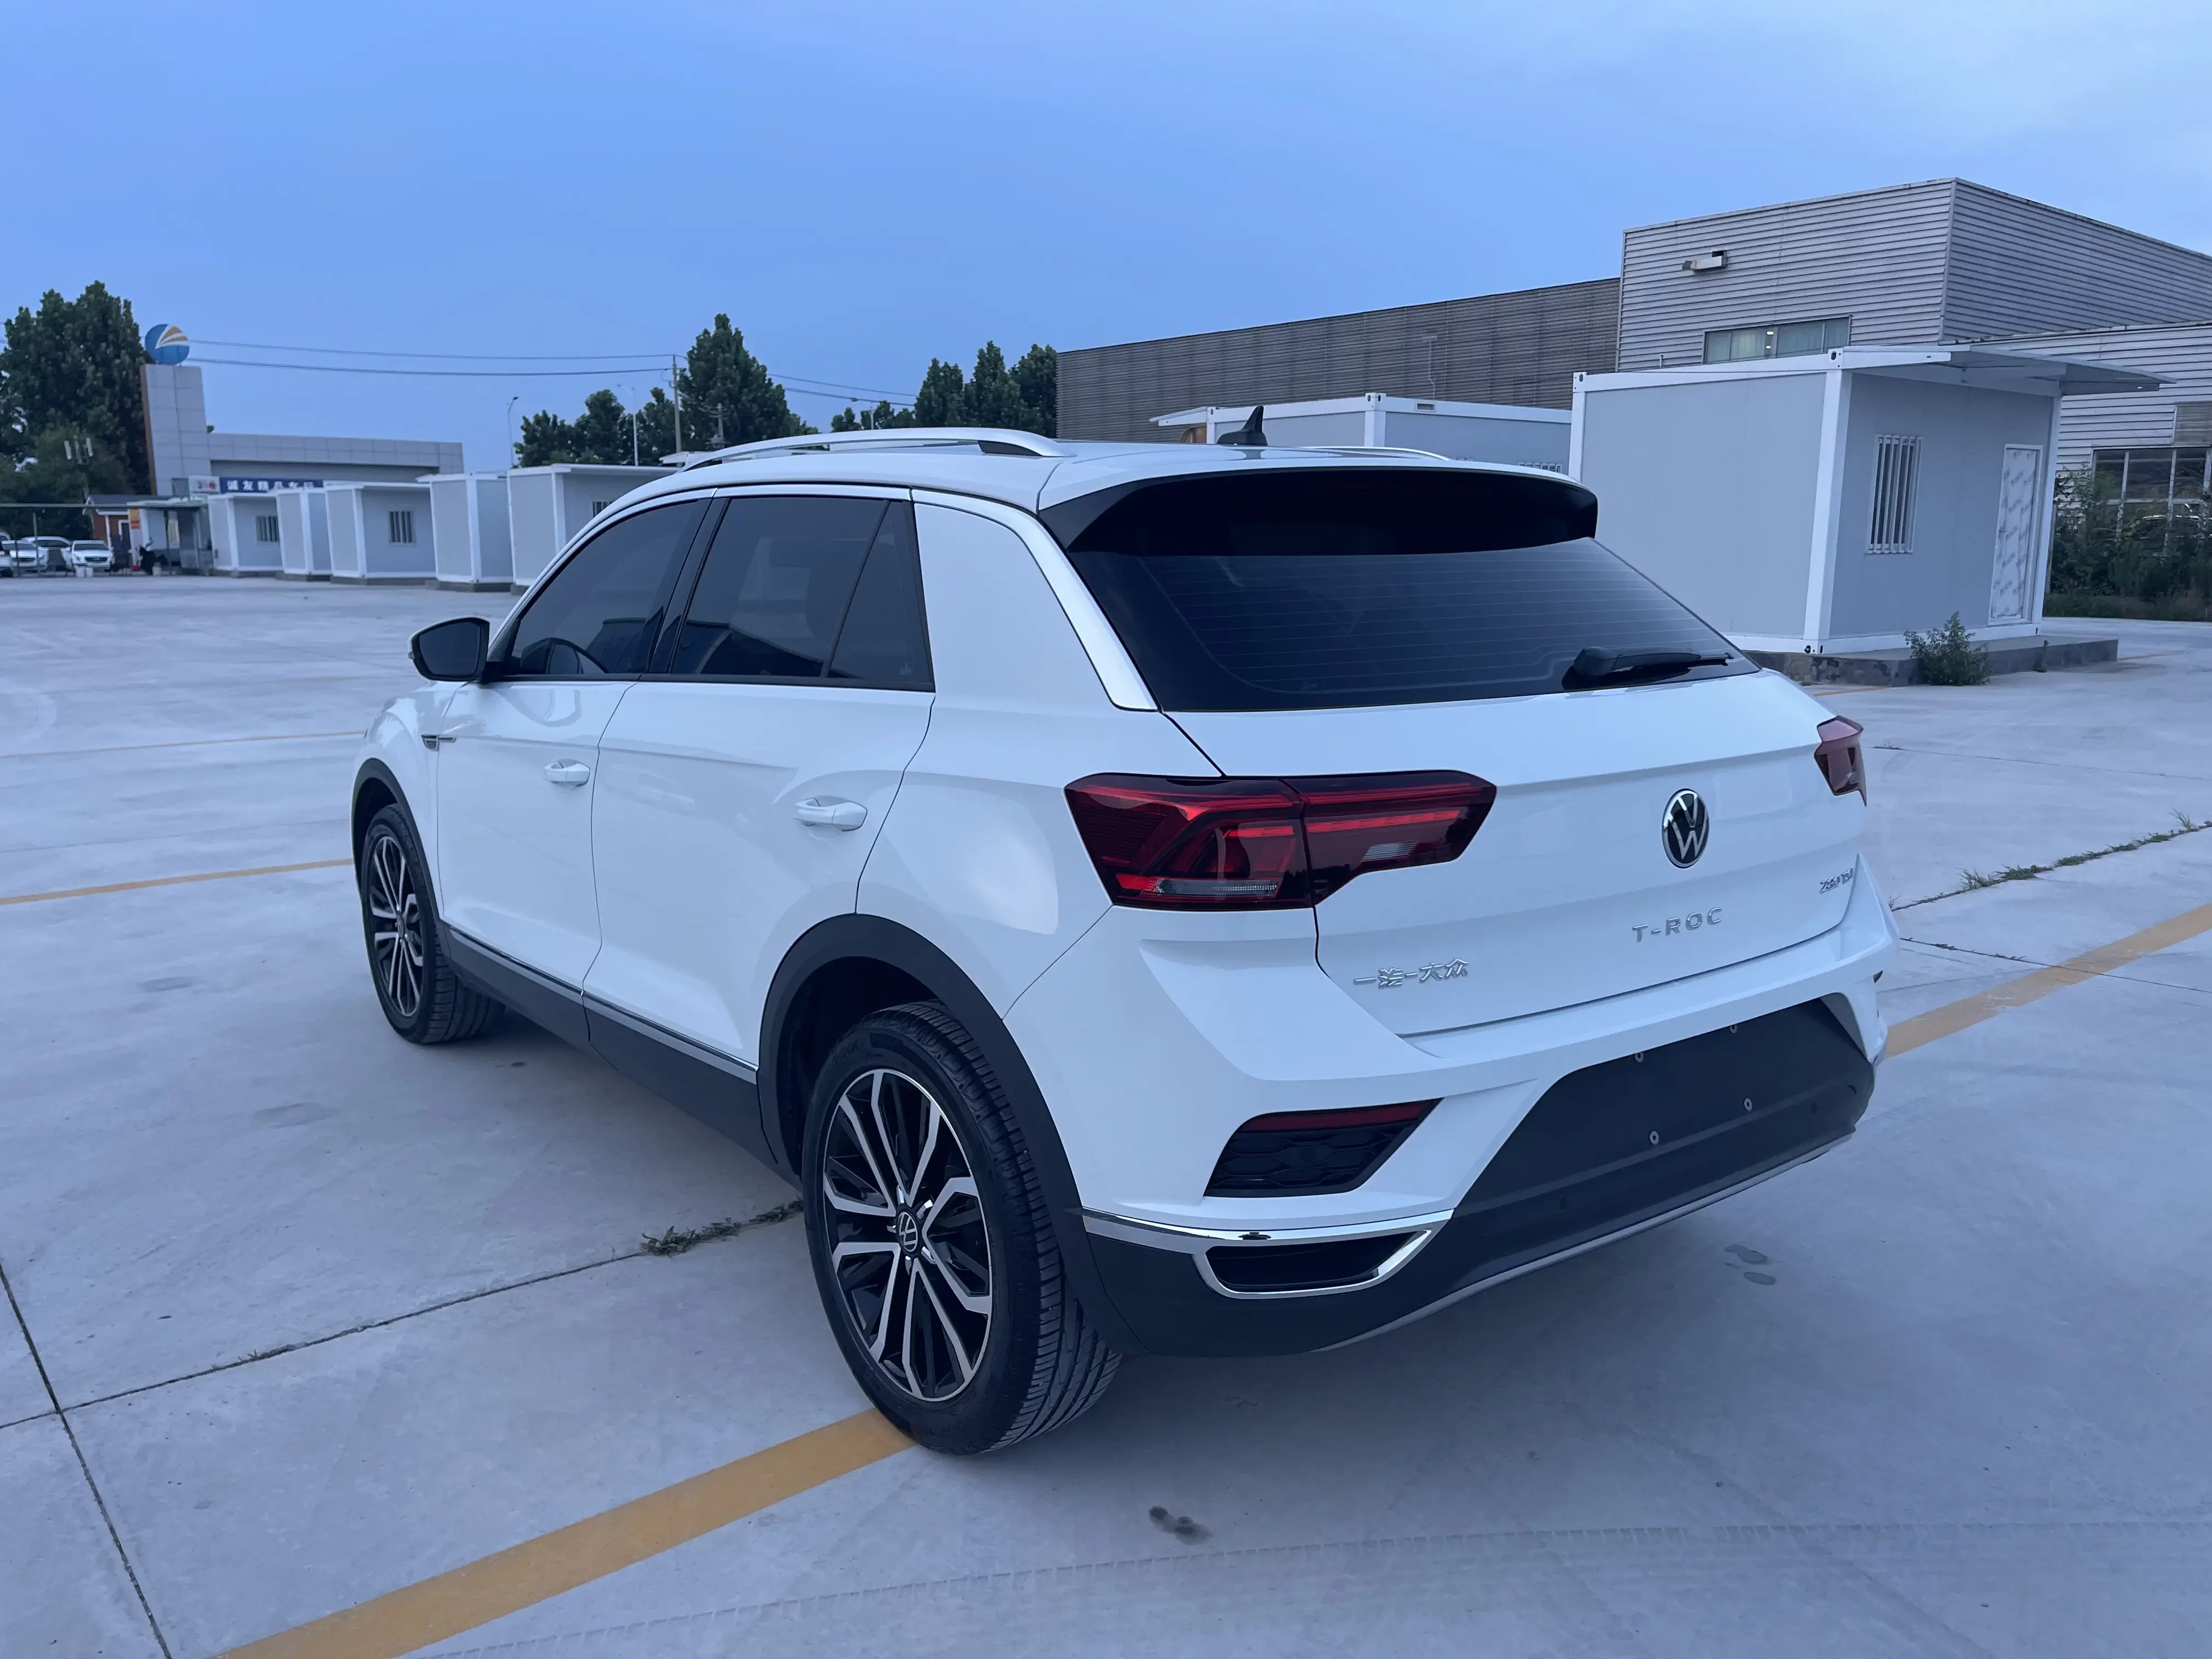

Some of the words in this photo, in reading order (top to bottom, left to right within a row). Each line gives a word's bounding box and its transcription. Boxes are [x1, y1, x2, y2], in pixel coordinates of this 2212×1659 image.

[1663, 791, 1708, 861] VW
[1632, 907, 1722, 943] T-ROC
[1353, 958, 1469, 990] 一汽-大众
